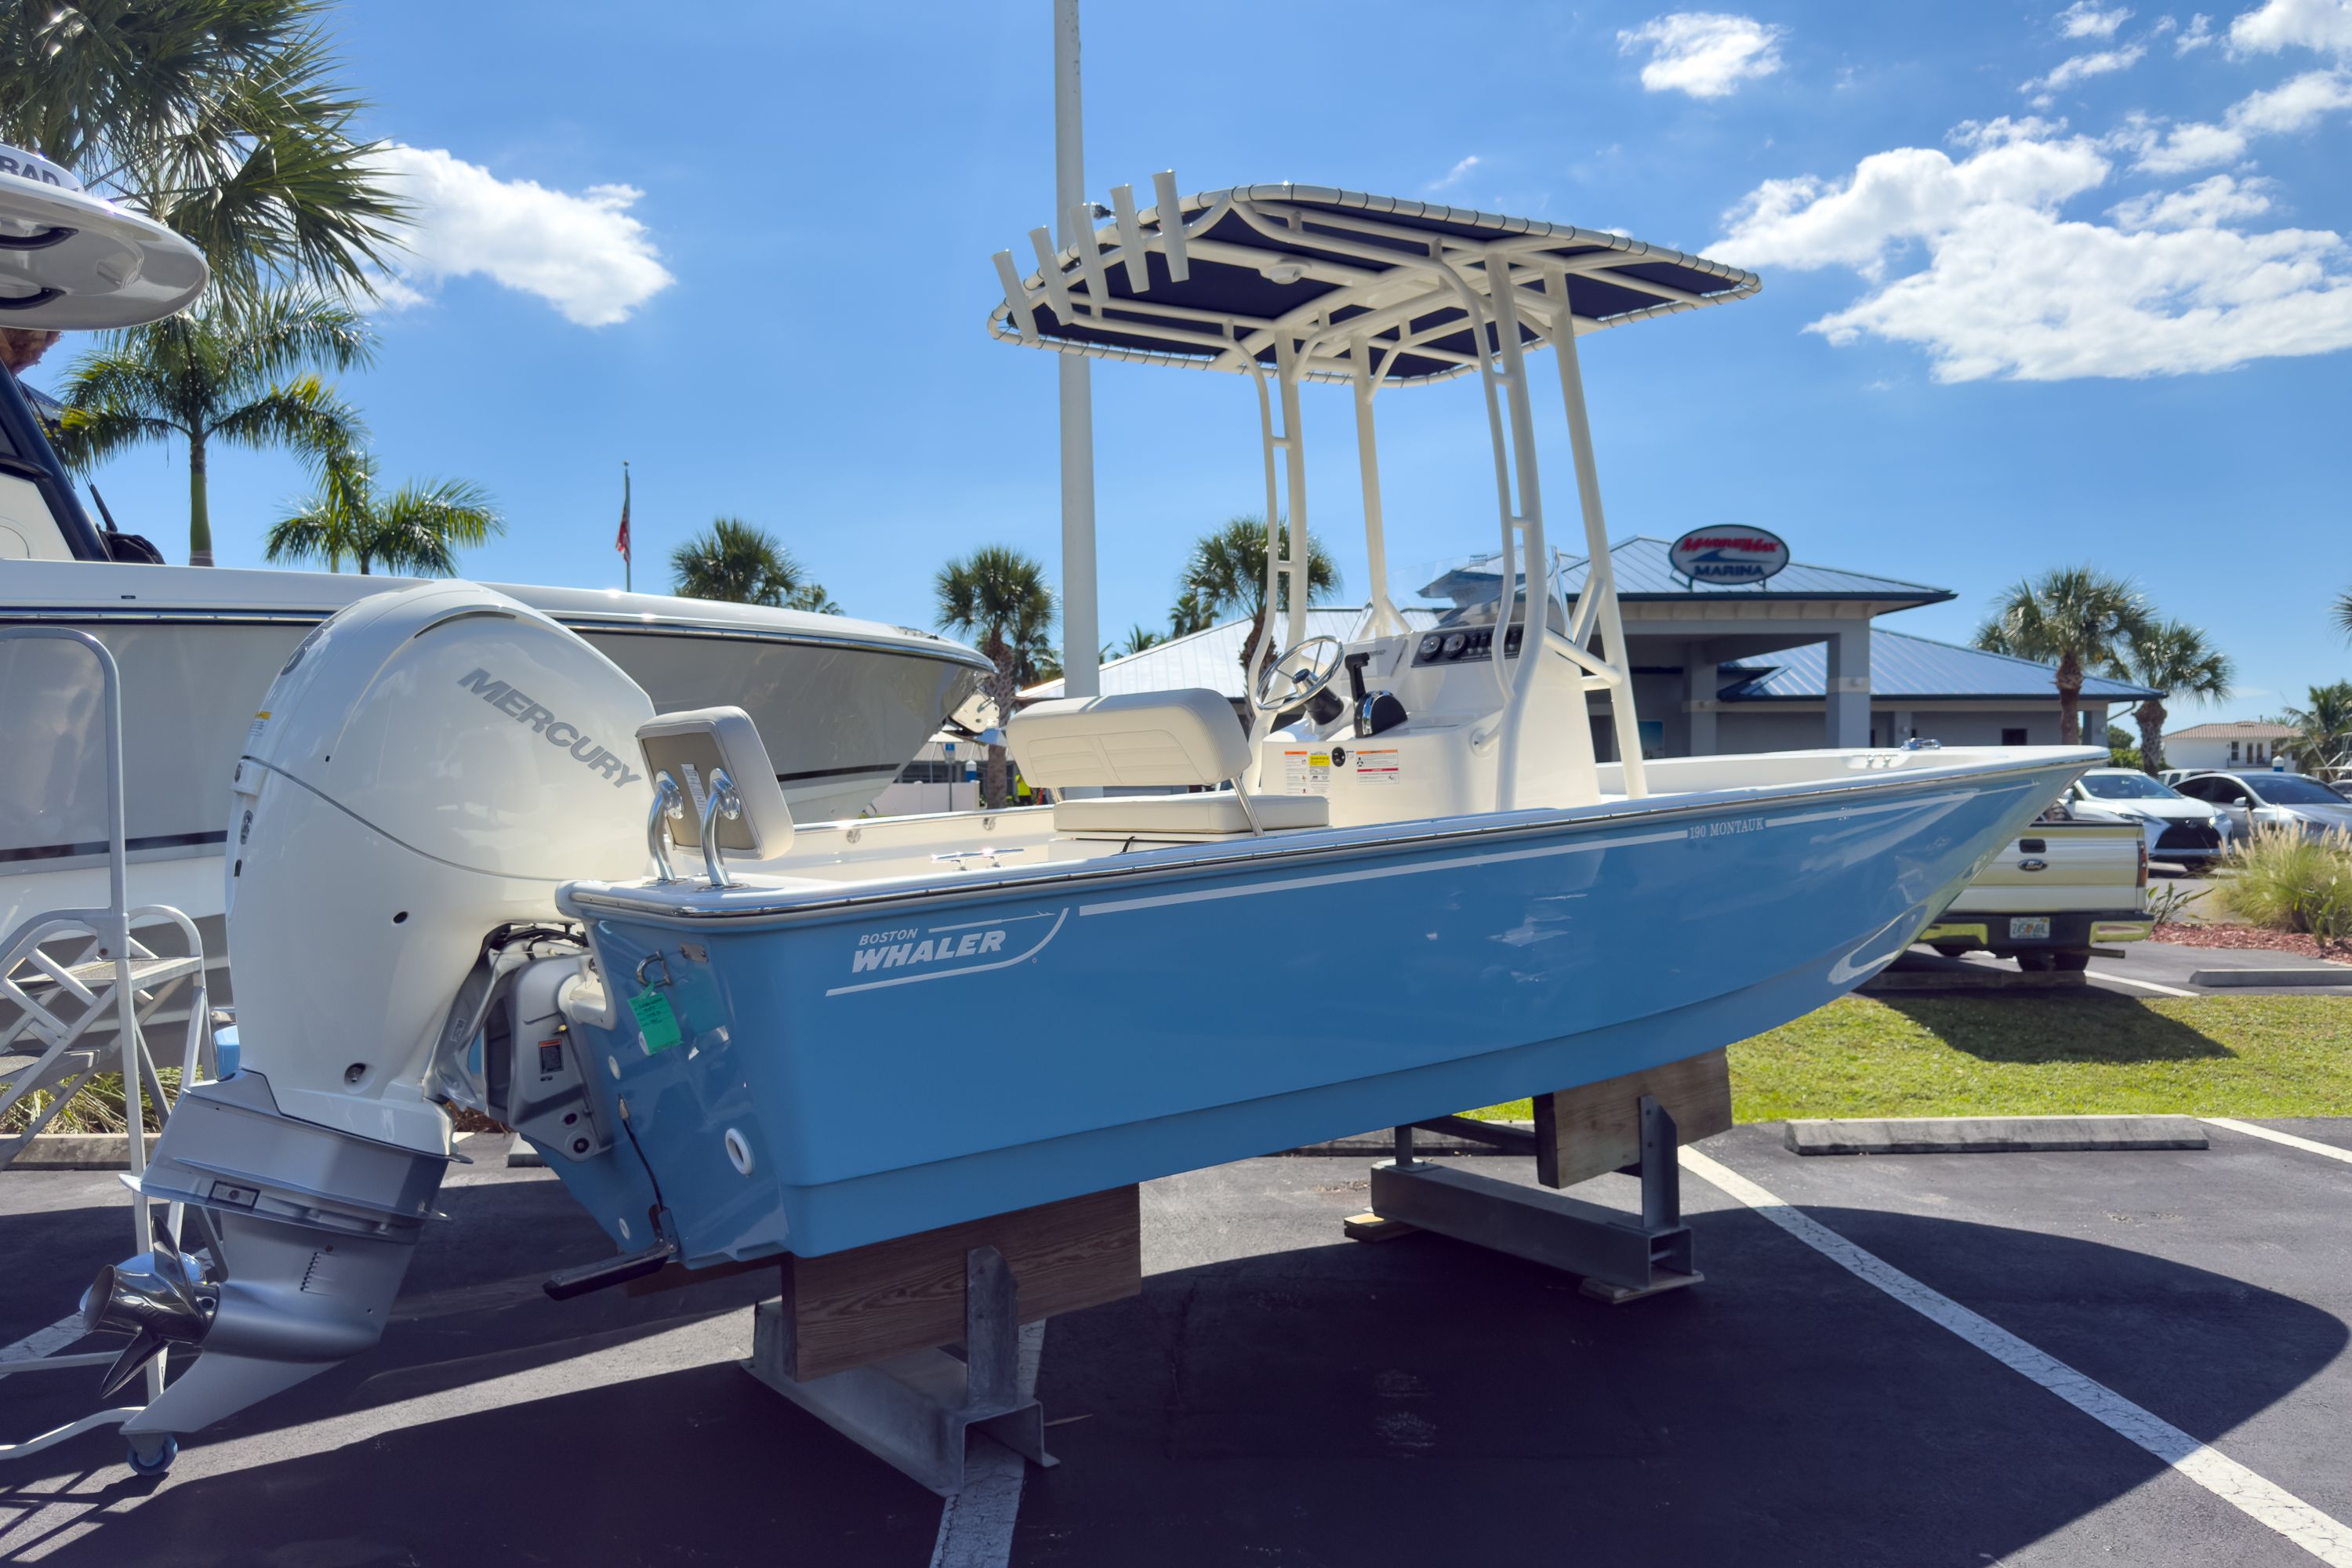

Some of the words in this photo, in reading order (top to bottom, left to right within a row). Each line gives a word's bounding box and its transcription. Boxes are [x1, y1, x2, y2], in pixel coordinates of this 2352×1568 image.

[1694, 565, 1765, 576] MARINA
[456, 667, 642, 789] MERCURY
[1689, 825, 1707, 840] 190
[1709, 817, 1765, 837] MONTAUK
[858, 927, 919, 946] BOSTON
[851, 929, 1007, 974] WHALER
